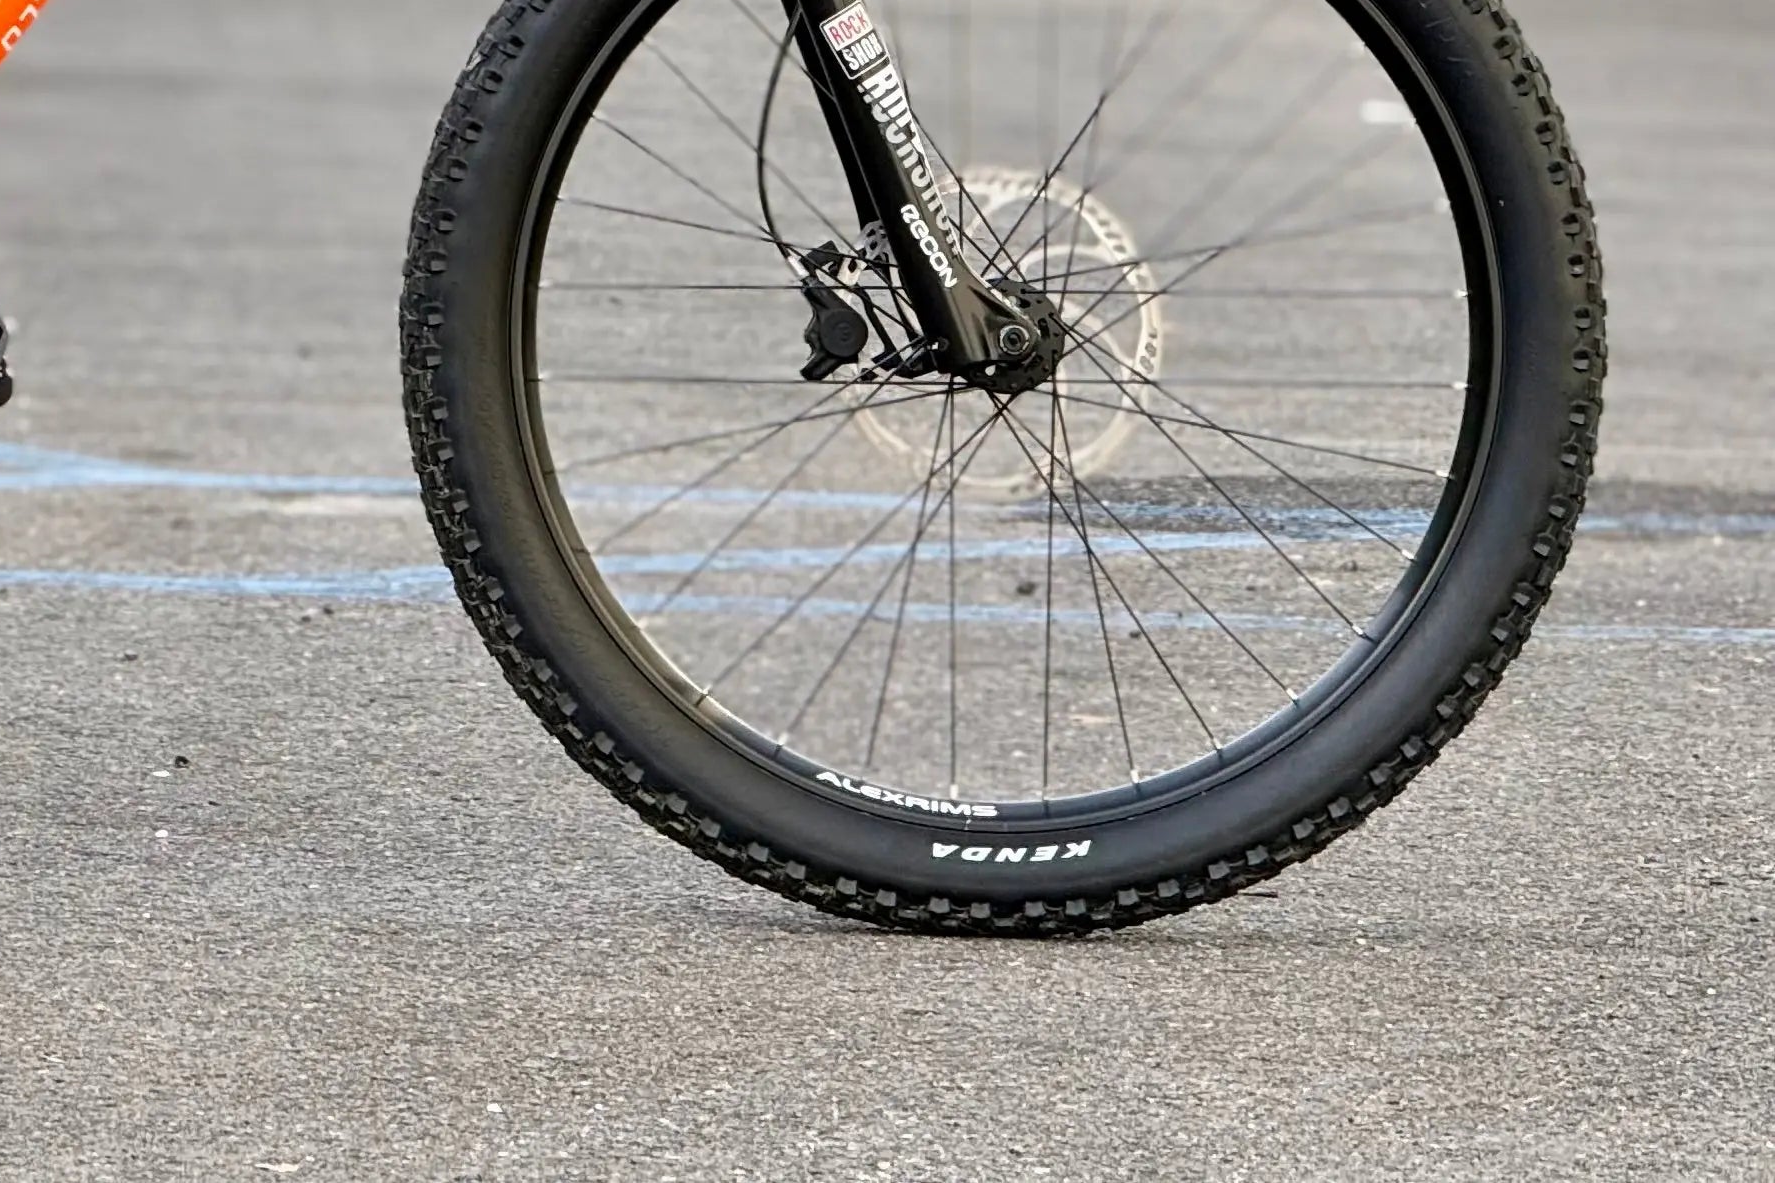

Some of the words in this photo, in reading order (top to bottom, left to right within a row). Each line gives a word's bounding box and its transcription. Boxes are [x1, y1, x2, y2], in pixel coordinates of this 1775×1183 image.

[828, 10, 874, 45] ROCK
[842, 32, 883, 71] SHOX
[900, 204, 958, 288] RECON
[816, 771, 998, 817] ALEXRIMS
[932, 840, 1092, 863] KENDA
